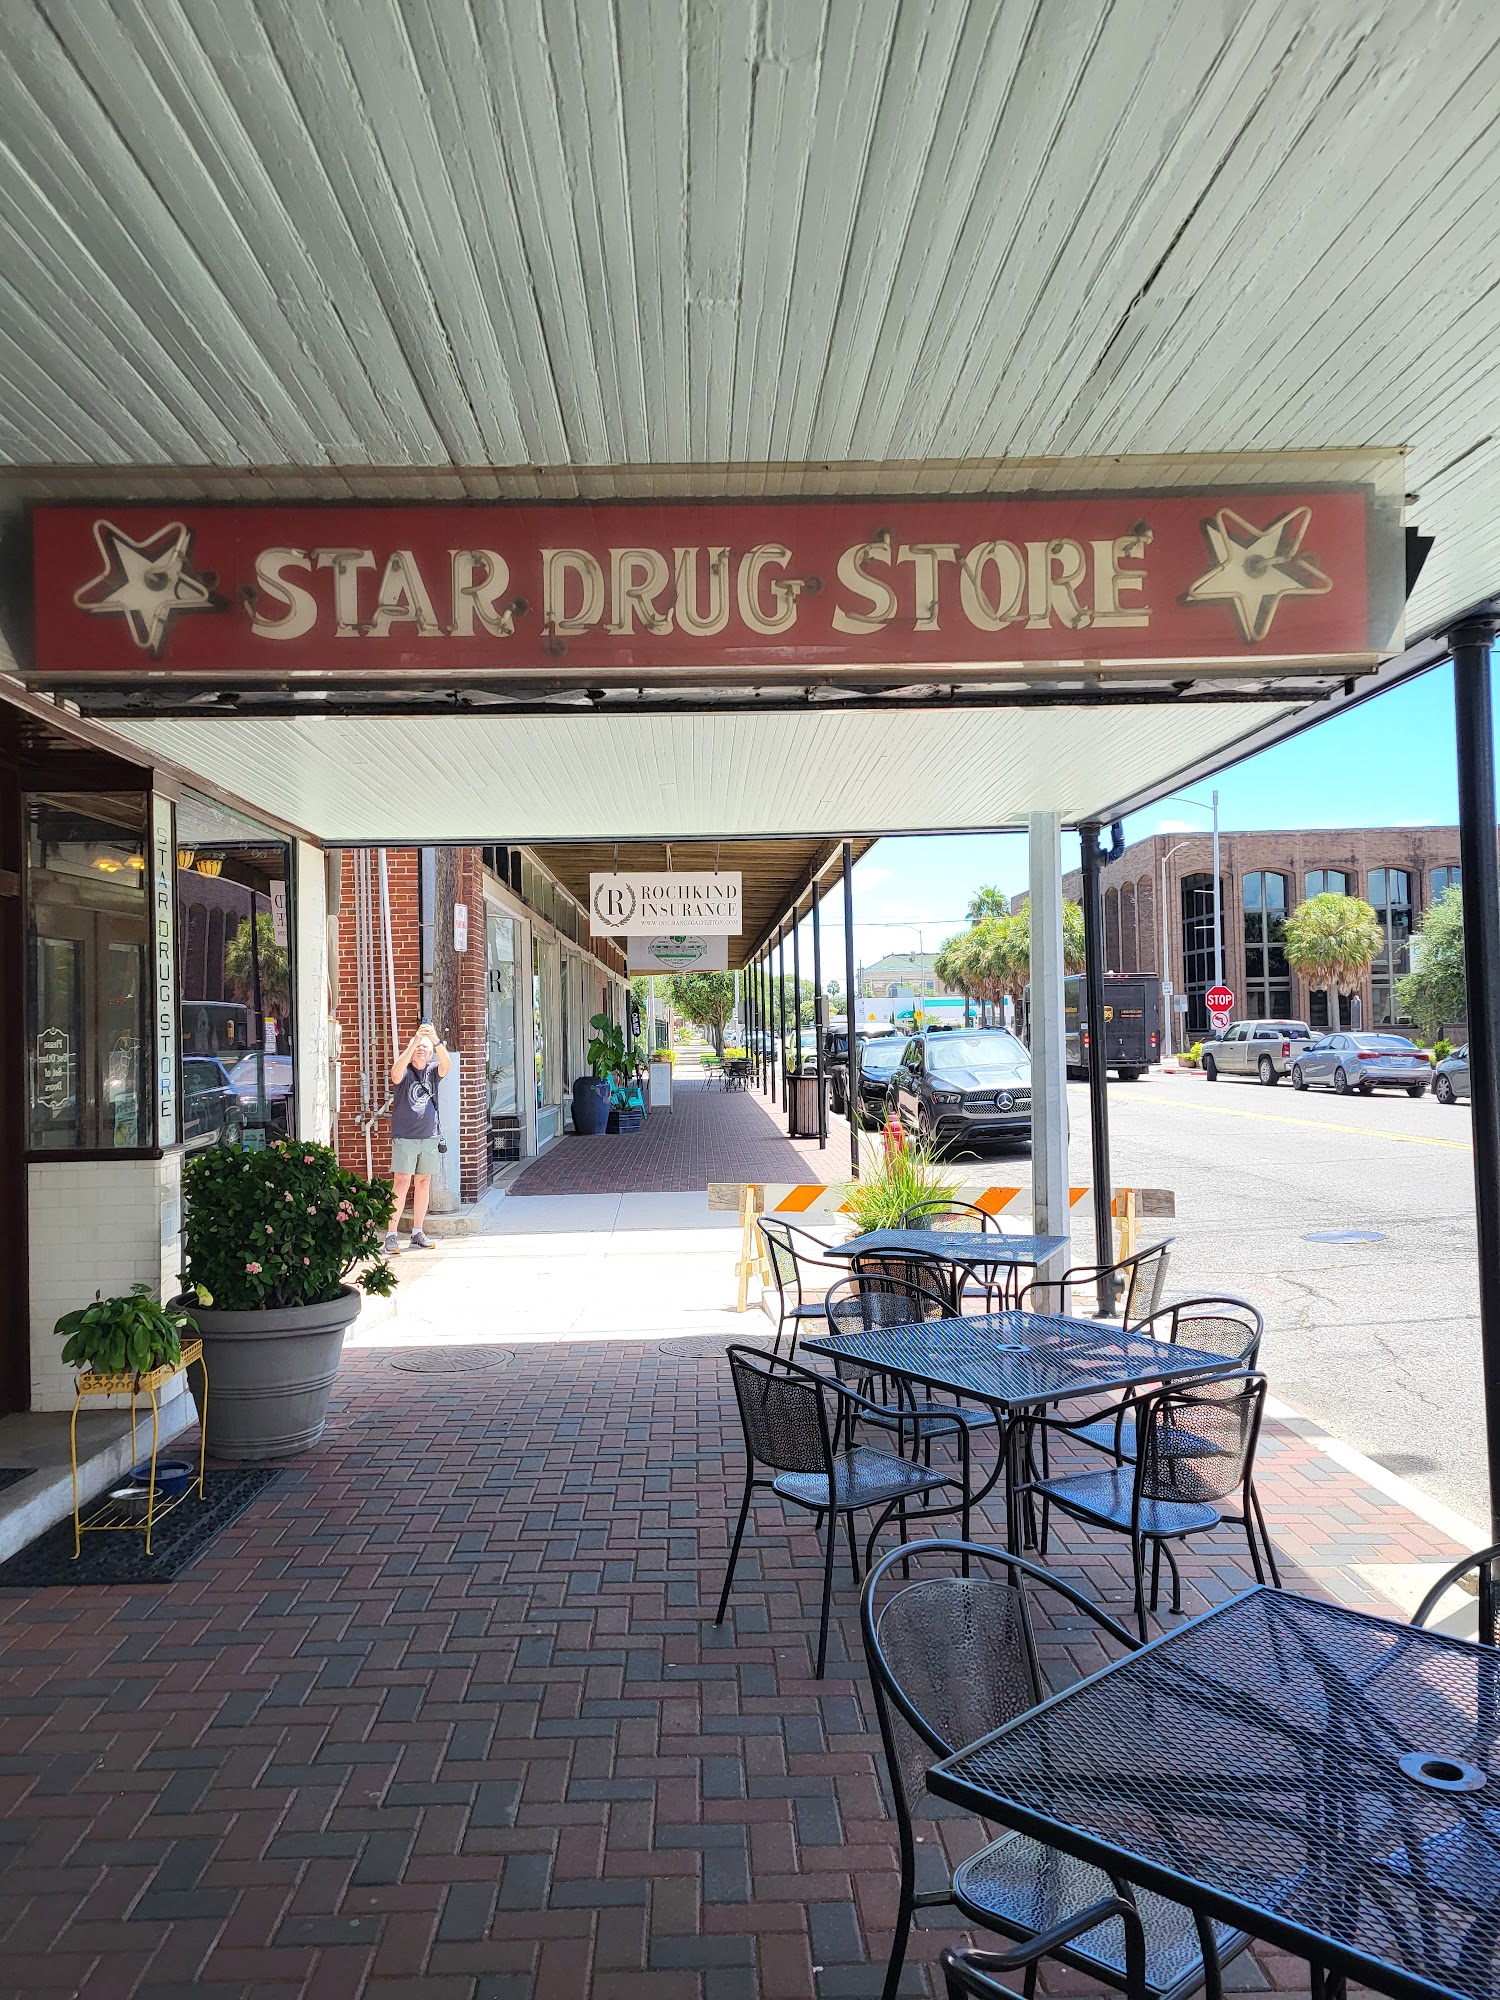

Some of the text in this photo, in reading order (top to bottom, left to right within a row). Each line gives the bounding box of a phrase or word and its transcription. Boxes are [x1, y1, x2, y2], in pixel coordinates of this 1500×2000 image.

[250, 540, 1151, 639] STAR DRUG STORE
[606, 889, 625, 915] R
[640, 885, 737, 899] ROCHKIND
[641, 903, 737, 917] INSURANCE
[156, 827, 172, 1118] STAR DRUG STORE
[1207, 994, 1232, 1005] STOP
